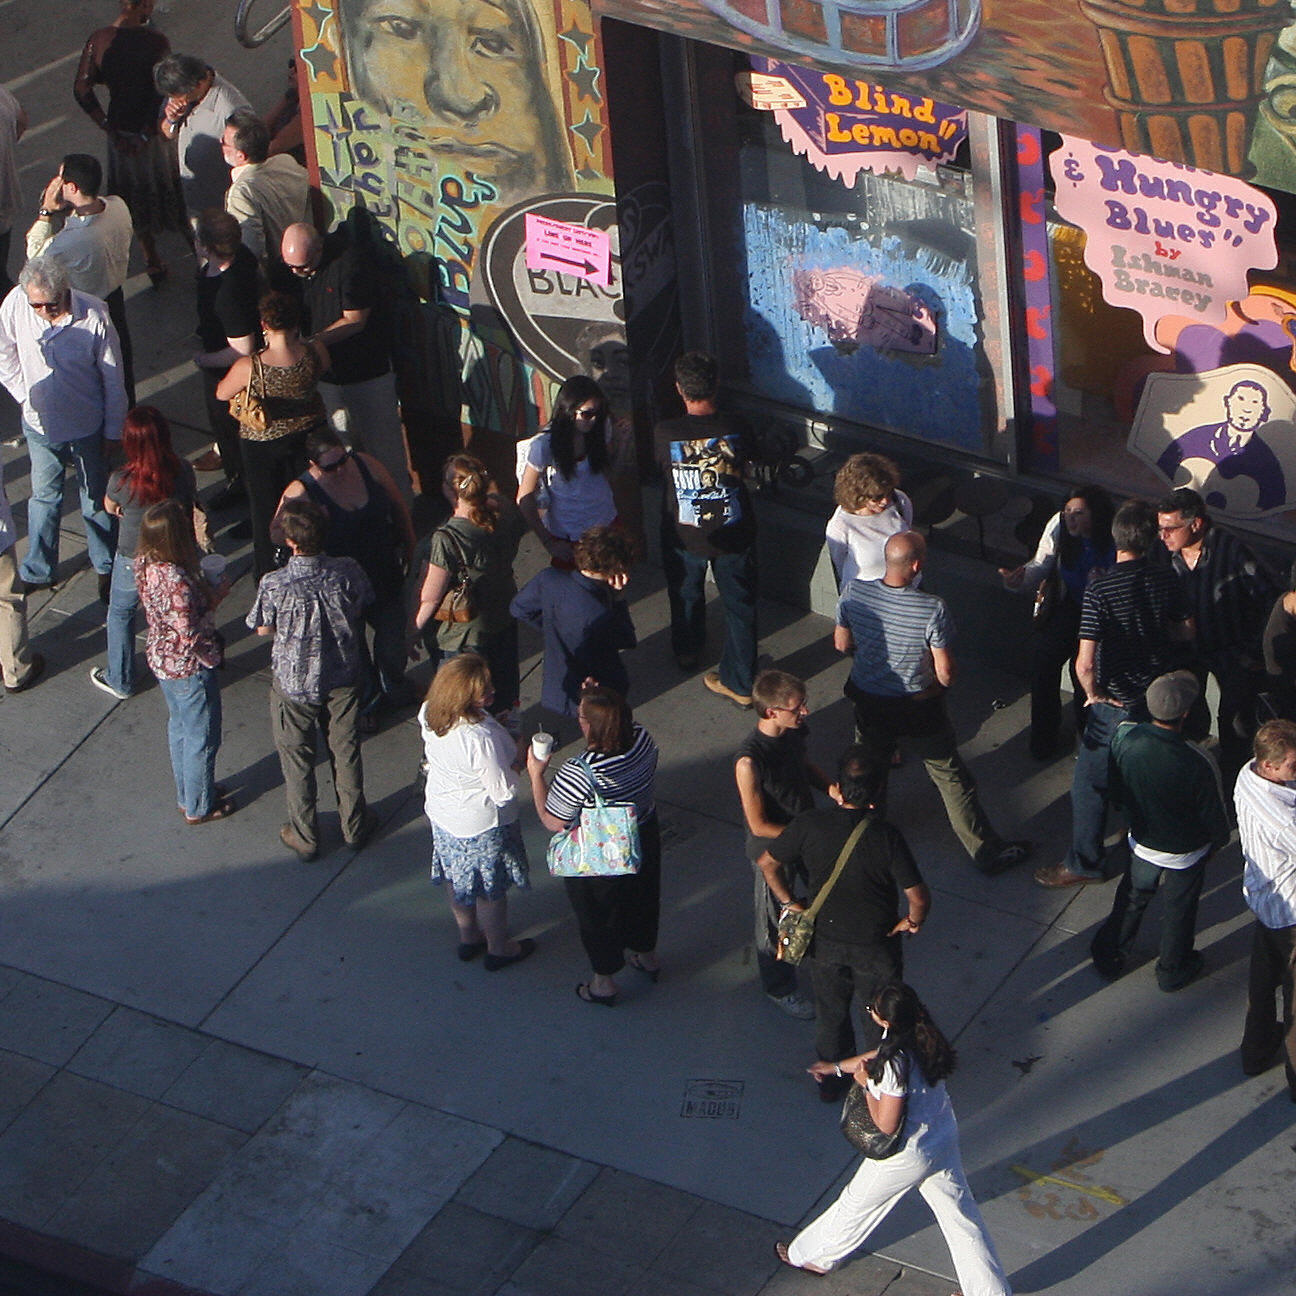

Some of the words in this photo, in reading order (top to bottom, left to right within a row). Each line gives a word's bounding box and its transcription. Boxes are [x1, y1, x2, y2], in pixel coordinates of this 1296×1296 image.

[822, 73, 938, 125] Blind
[1094, 155, 1273, 233] Hungry
[1154, 240, 1183, 262] by
[1113, 269, 1214, 314] Bracey
